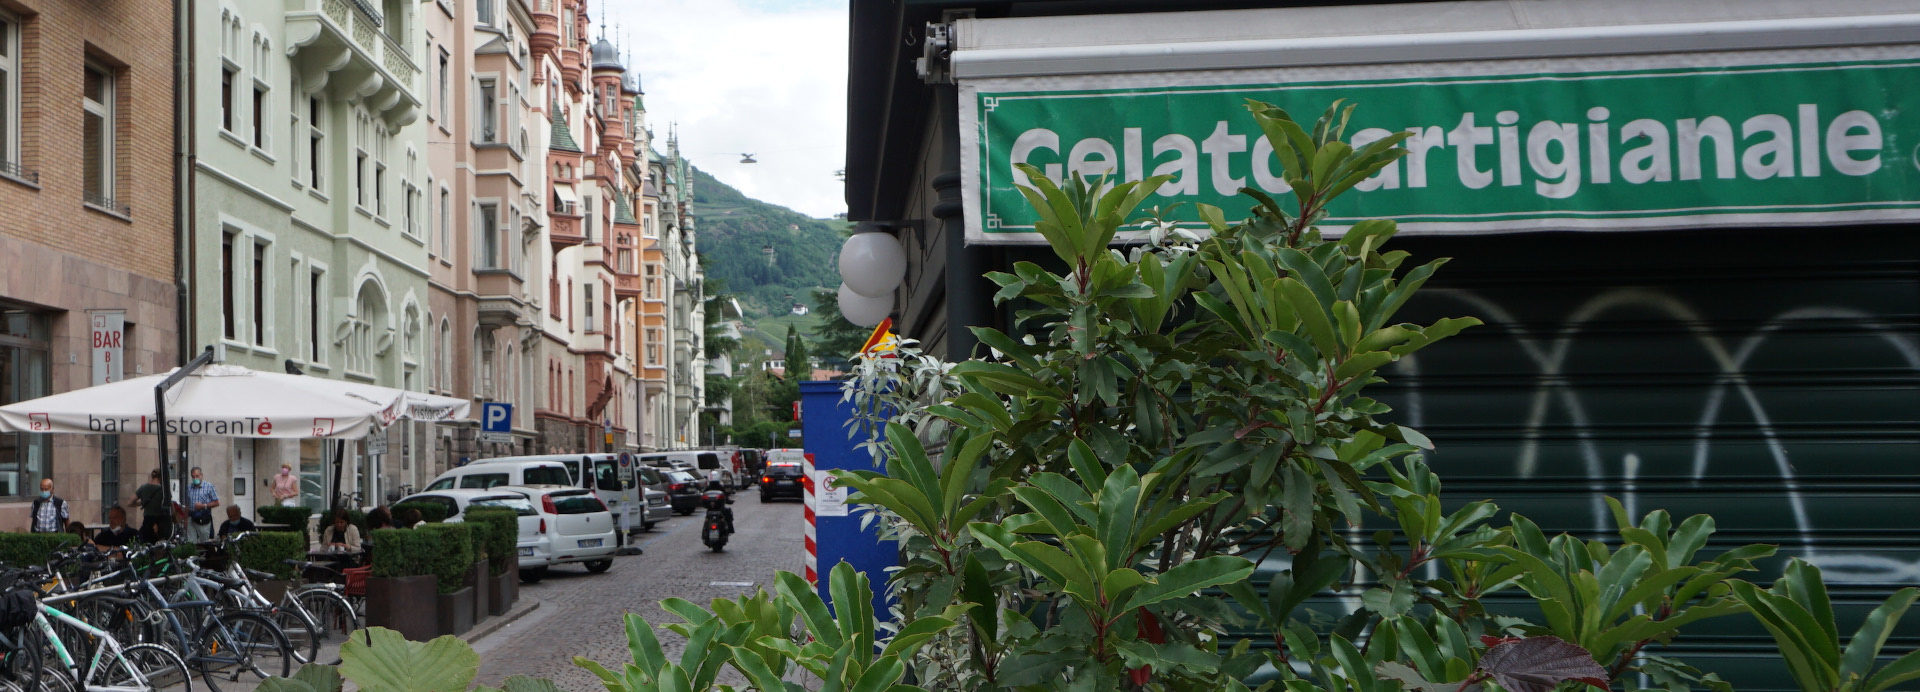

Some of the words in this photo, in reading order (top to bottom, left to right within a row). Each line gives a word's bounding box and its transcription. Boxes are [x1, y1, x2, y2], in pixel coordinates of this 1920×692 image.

[1350, 104, 1884, 199] artigianale
[93, 331, 121, 348] BAR
[88, 413, 129, 433] bar
[487, 405, 507, 429] P
